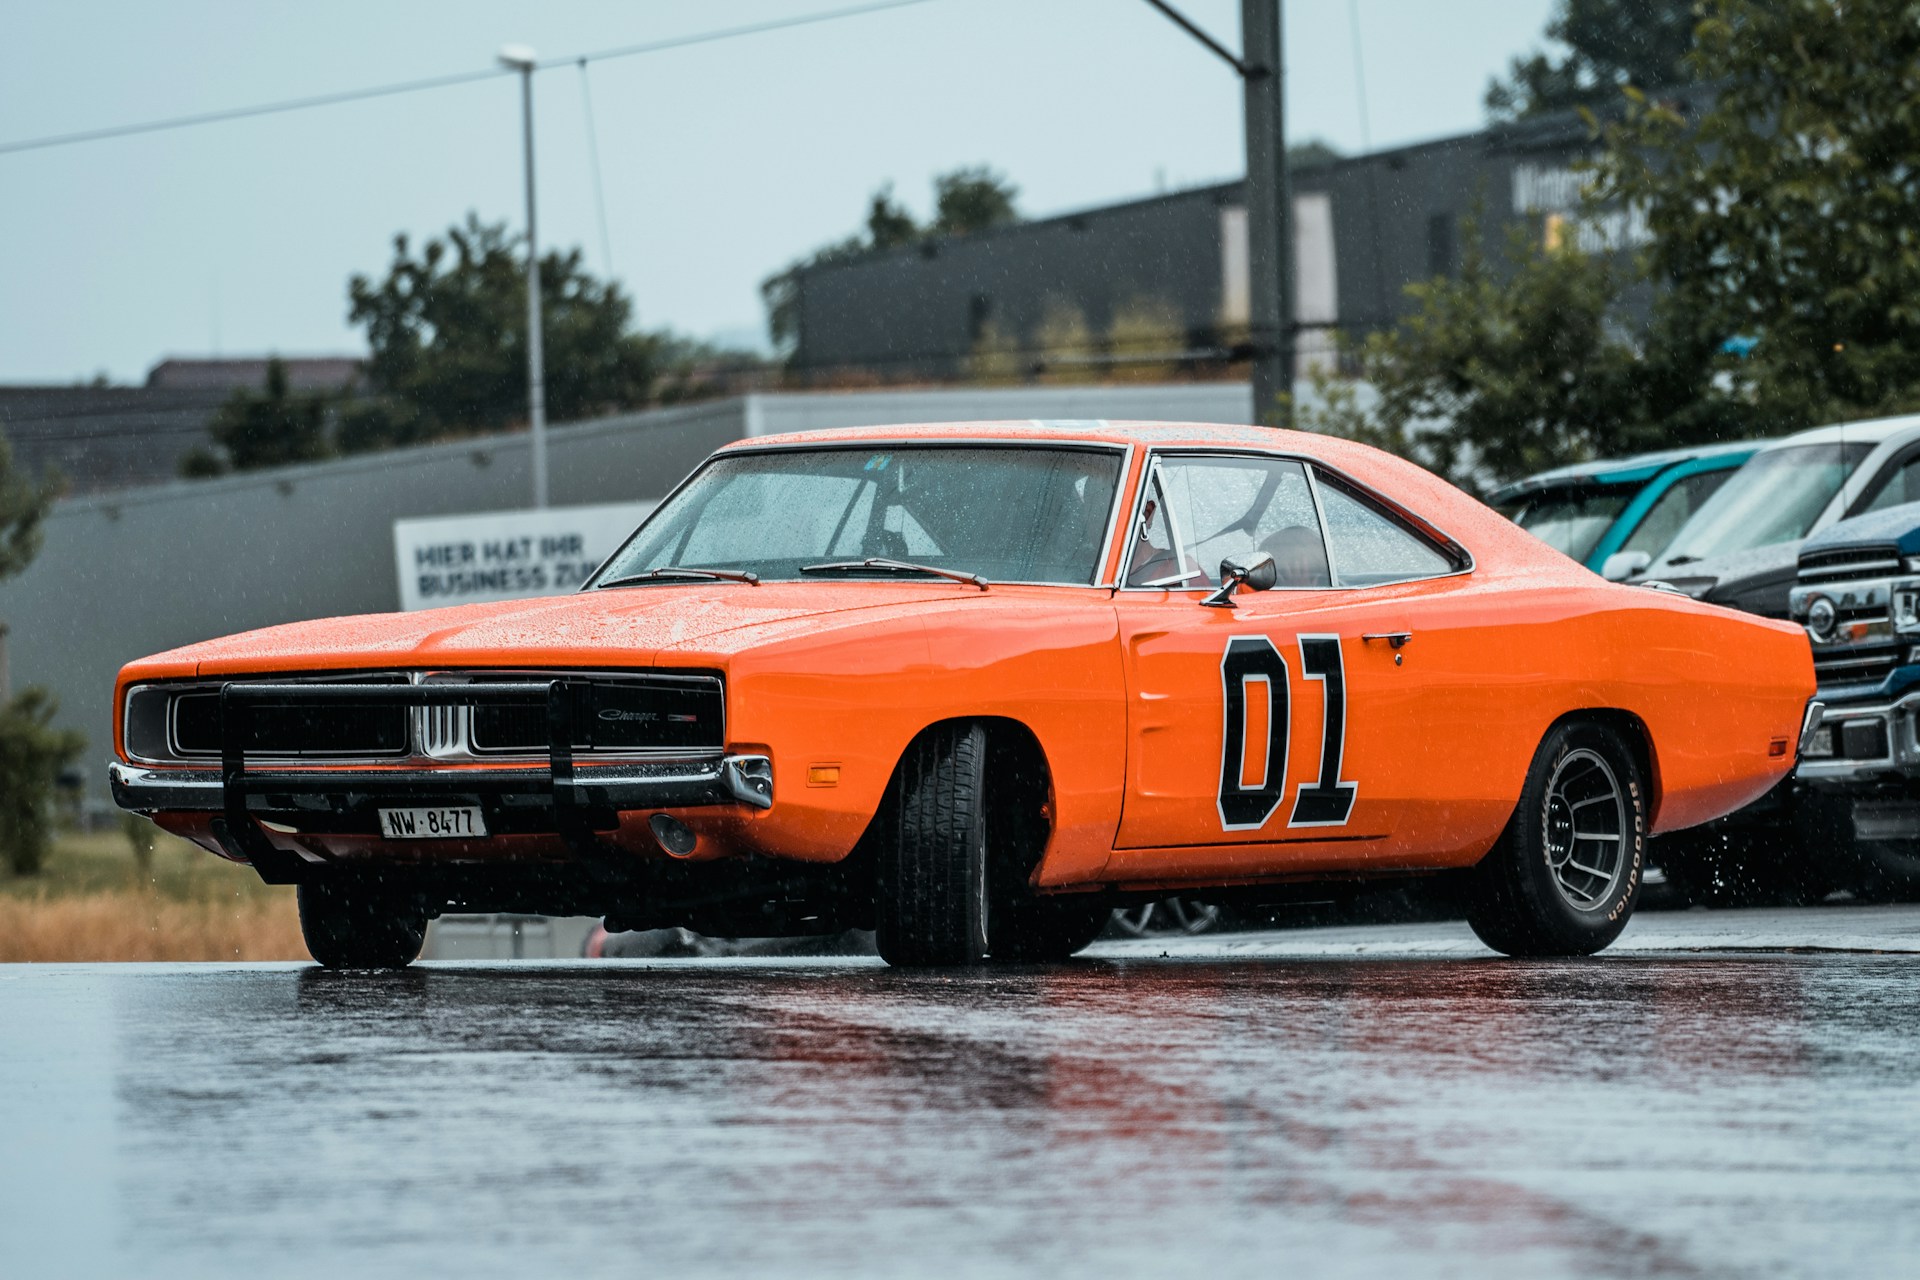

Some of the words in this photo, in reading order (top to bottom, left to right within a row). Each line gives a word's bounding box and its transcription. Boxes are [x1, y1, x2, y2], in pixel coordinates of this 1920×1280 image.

[415, 543, 476, 567] HIER
[482, 538, 532, 562] HAT
[540, 534, 583, 557] IHR
[418, 566, 548, 598] BUSINESS
[598, 708, 660, 724] Charger
[1217, 633, 1359, 832] 01
[1607, 781, 1643, 922] BFGoodrich
